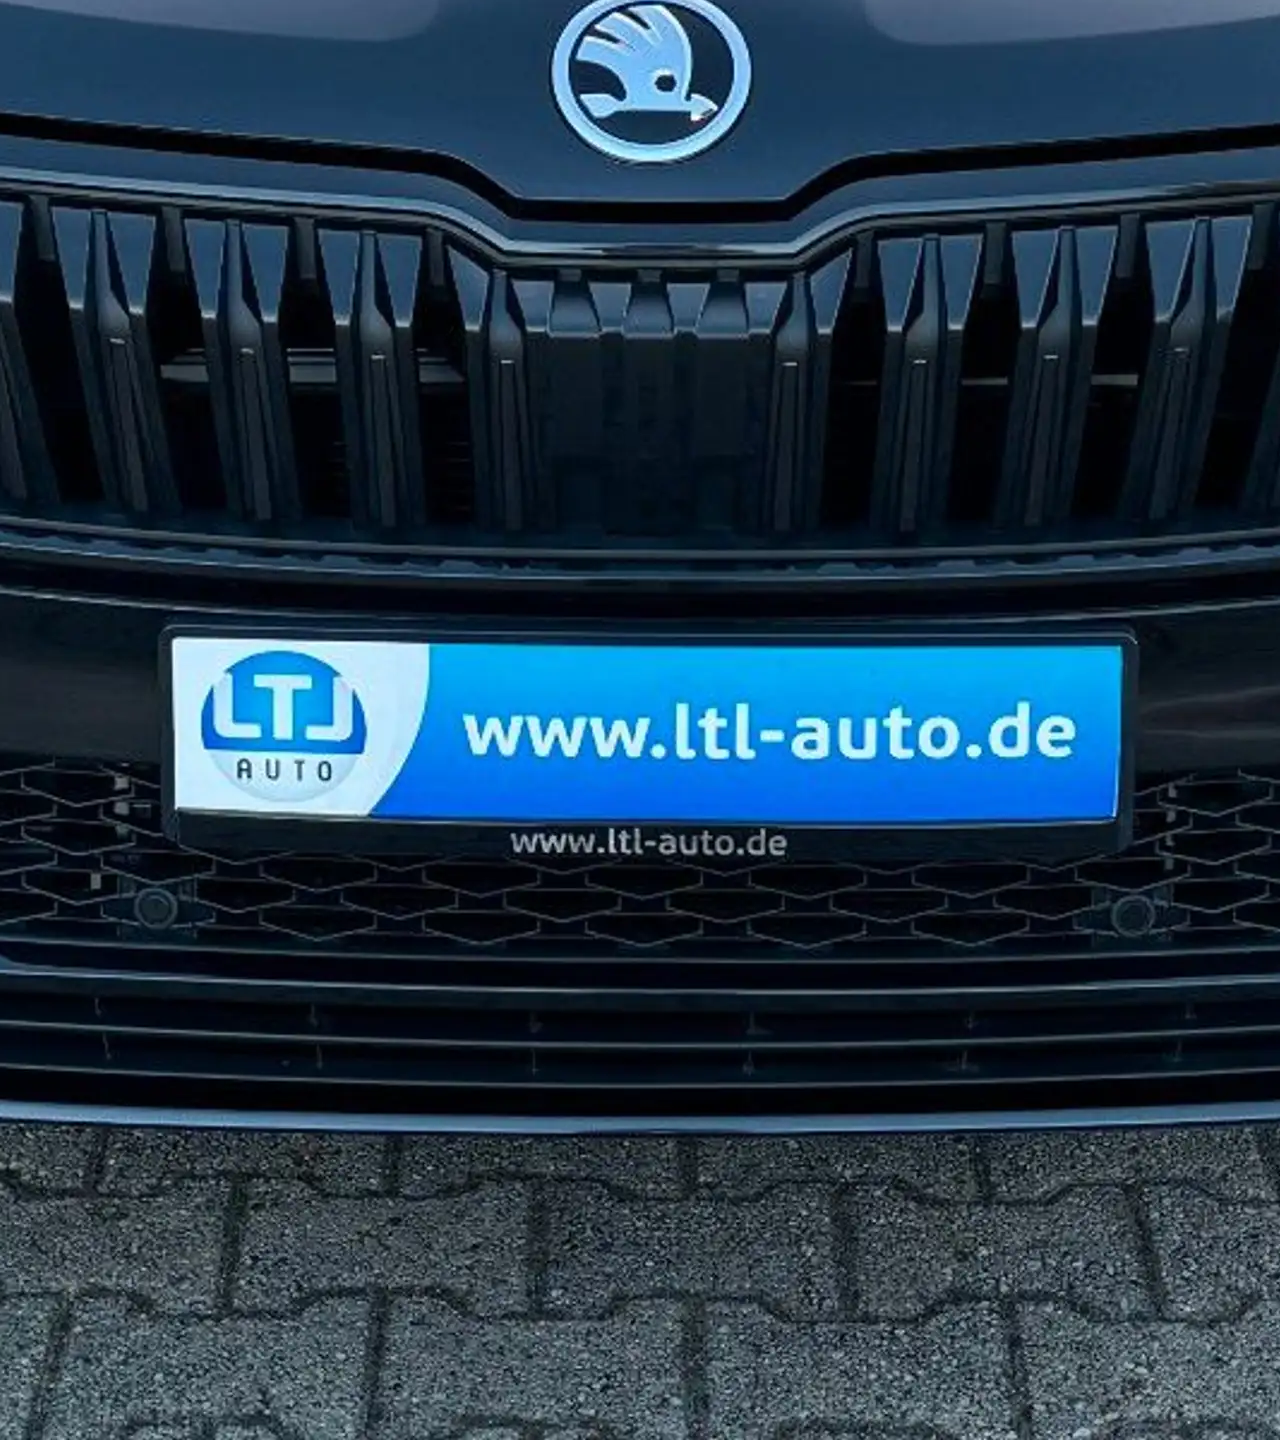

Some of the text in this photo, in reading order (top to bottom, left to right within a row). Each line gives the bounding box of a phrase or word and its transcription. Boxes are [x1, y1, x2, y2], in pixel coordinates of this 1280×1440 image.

[462, 700, 1077, 760] www.ltl-auto.de
[236, 758, 333, 782] AUTO
[510, 827, 788, 857] www.ltl-auto.de
